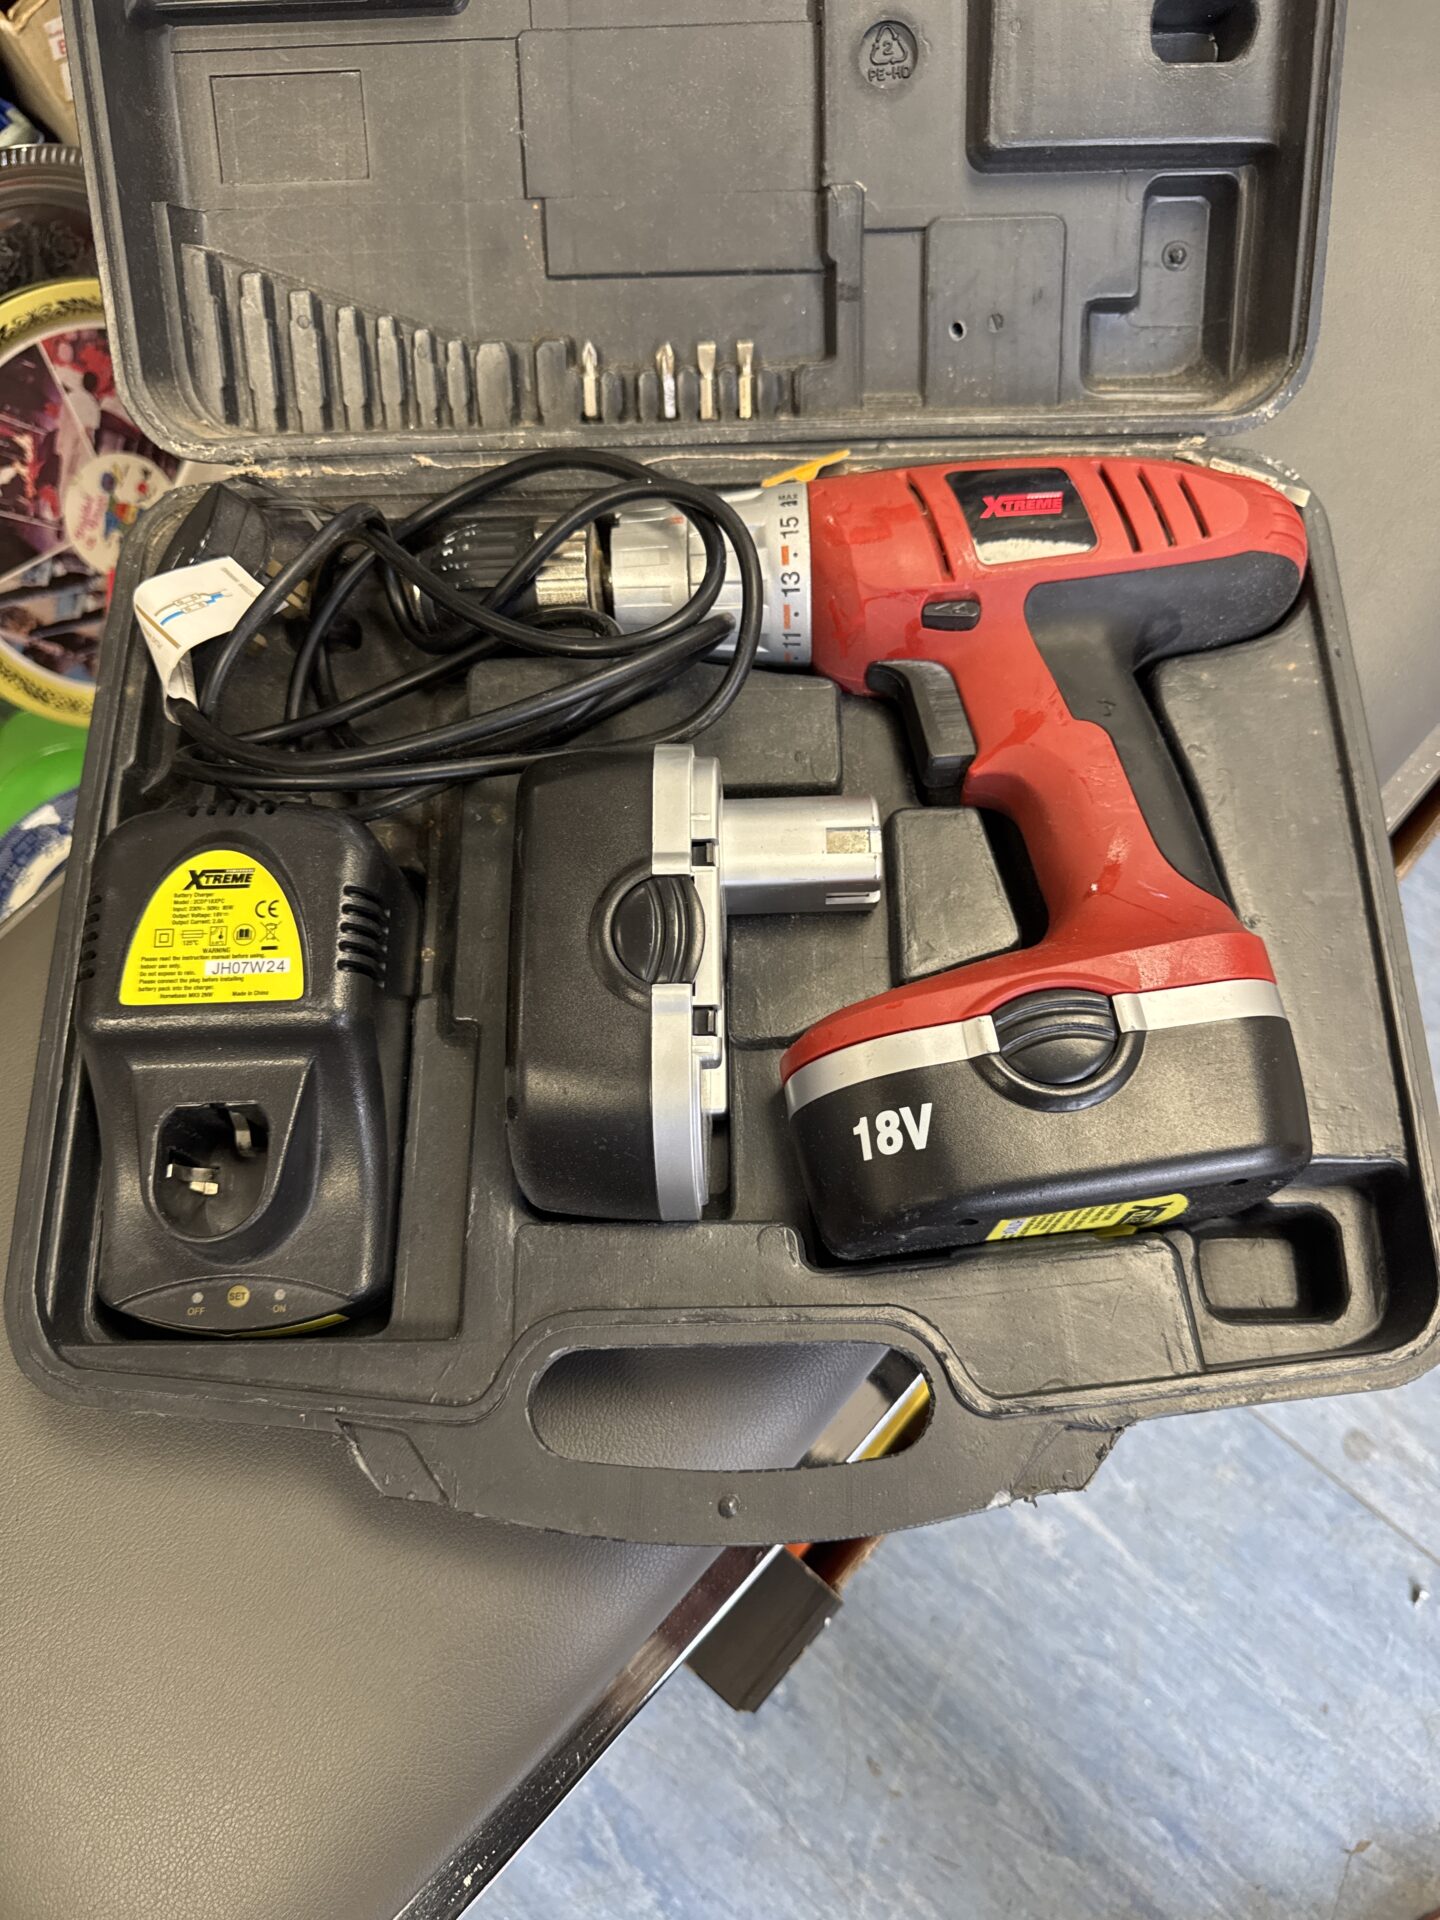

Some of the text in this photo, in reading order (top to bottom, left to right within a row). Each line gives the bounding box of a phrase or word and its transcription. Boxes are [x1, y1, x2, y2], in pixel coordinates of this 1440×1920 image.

[882, 40, 895, 56] 2
[868, 66, 912, 82] PE-HD
[980, 491, 1063, 518] XTREME
[780, 516, 800, 540] 15
[781, 571, 801, 598] 13
[782, 633, 802, 649] 11
[183, 868, 255, 891] XTREME
[202, 946, 231, 954] WARNING
[211, 959, 286, 975] JH07W24
[852, 1102, 932, 1162] 18V
[229, 1291, 246, 1301] SET
[186, 1306, 206, 1316] OFF
[272, 1304, 287, 1313] ON
